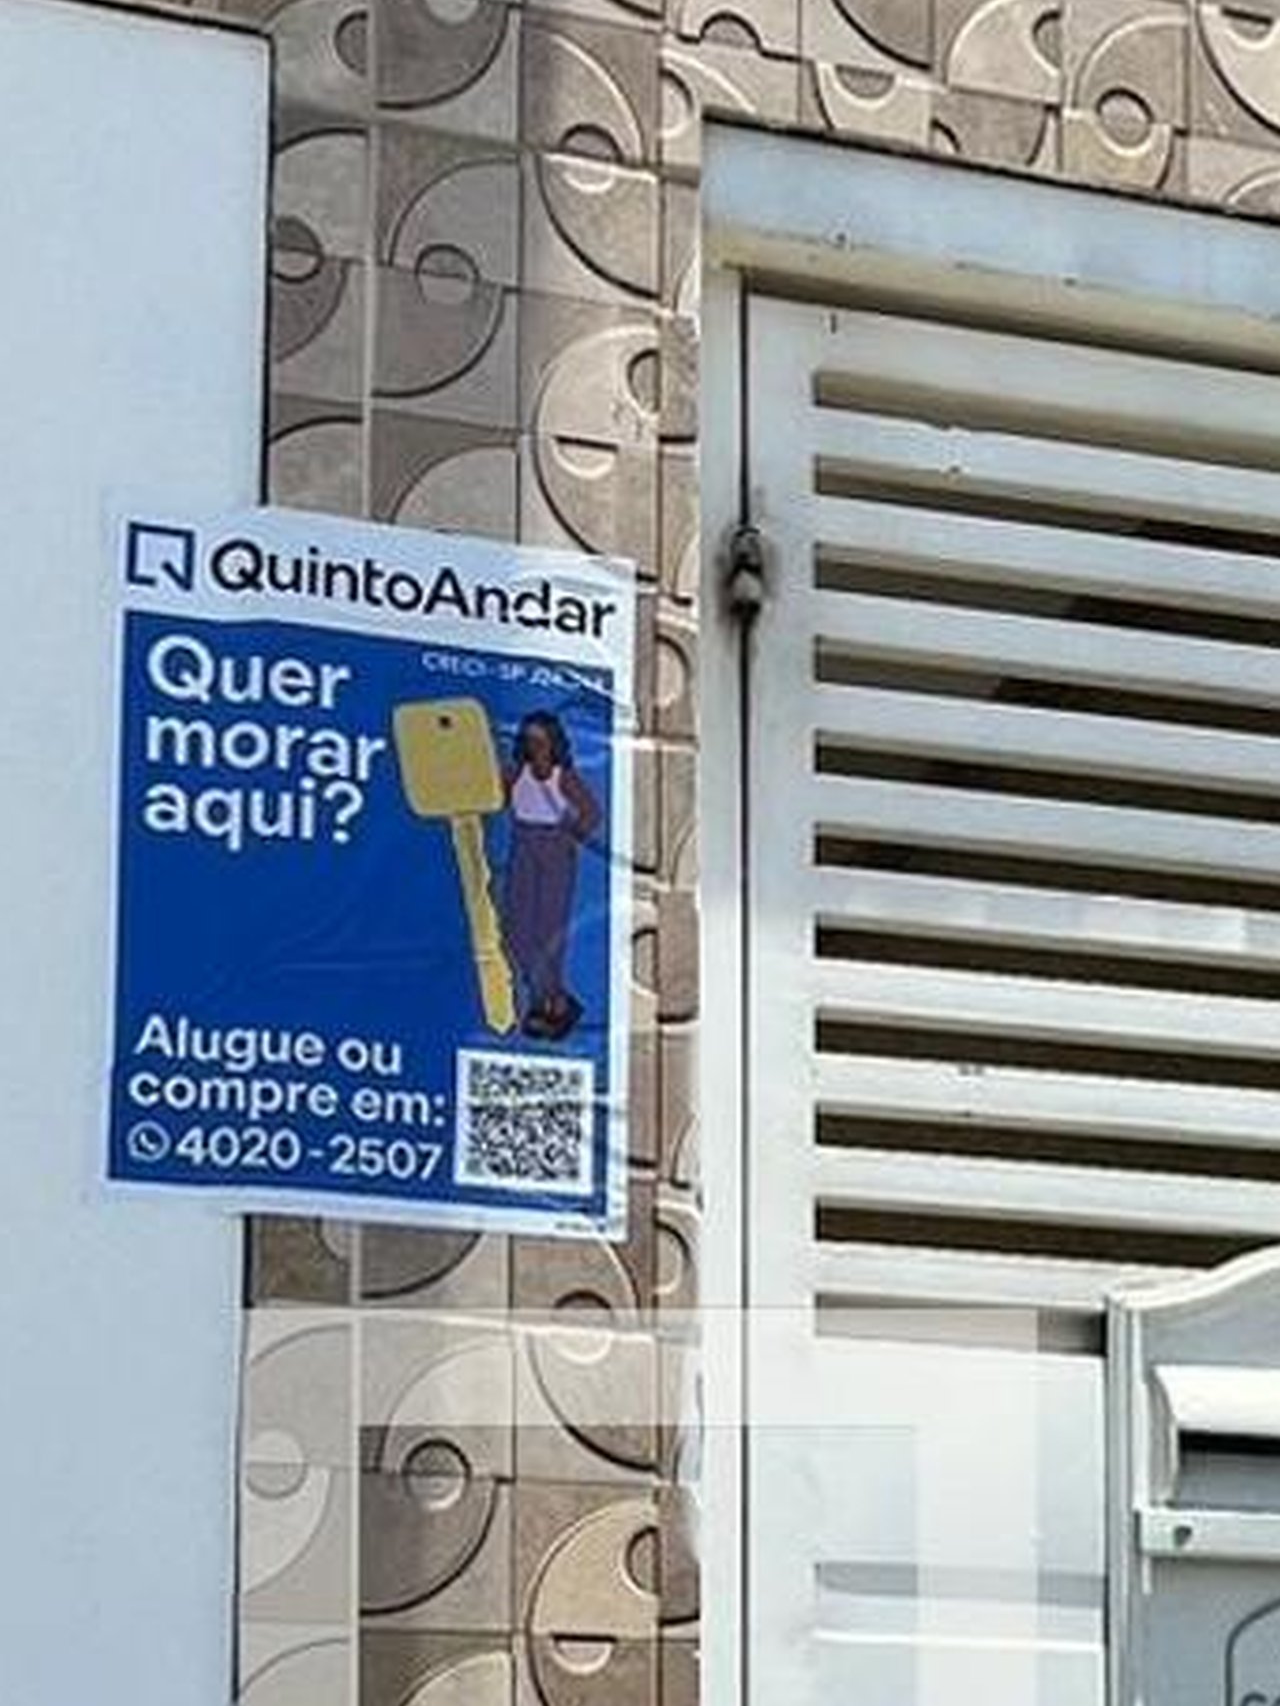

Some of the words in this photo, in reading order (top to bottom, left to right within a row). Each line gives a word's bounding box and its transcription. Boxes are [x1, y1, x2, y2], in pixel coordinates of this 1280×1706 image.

[210, 538, 617, 638] QuintoAndar
[146, 634, 352, 709] Quer
[146, 714, 387, 782] morar
[144, 775, 365, 852] aqui?
[133, 1013, 326, 1073] Alugue
[337, 1038, 402, 1076] ou
[128, 1071, 339, 1121] compre
[349, 1086, 446, 1127] em:
